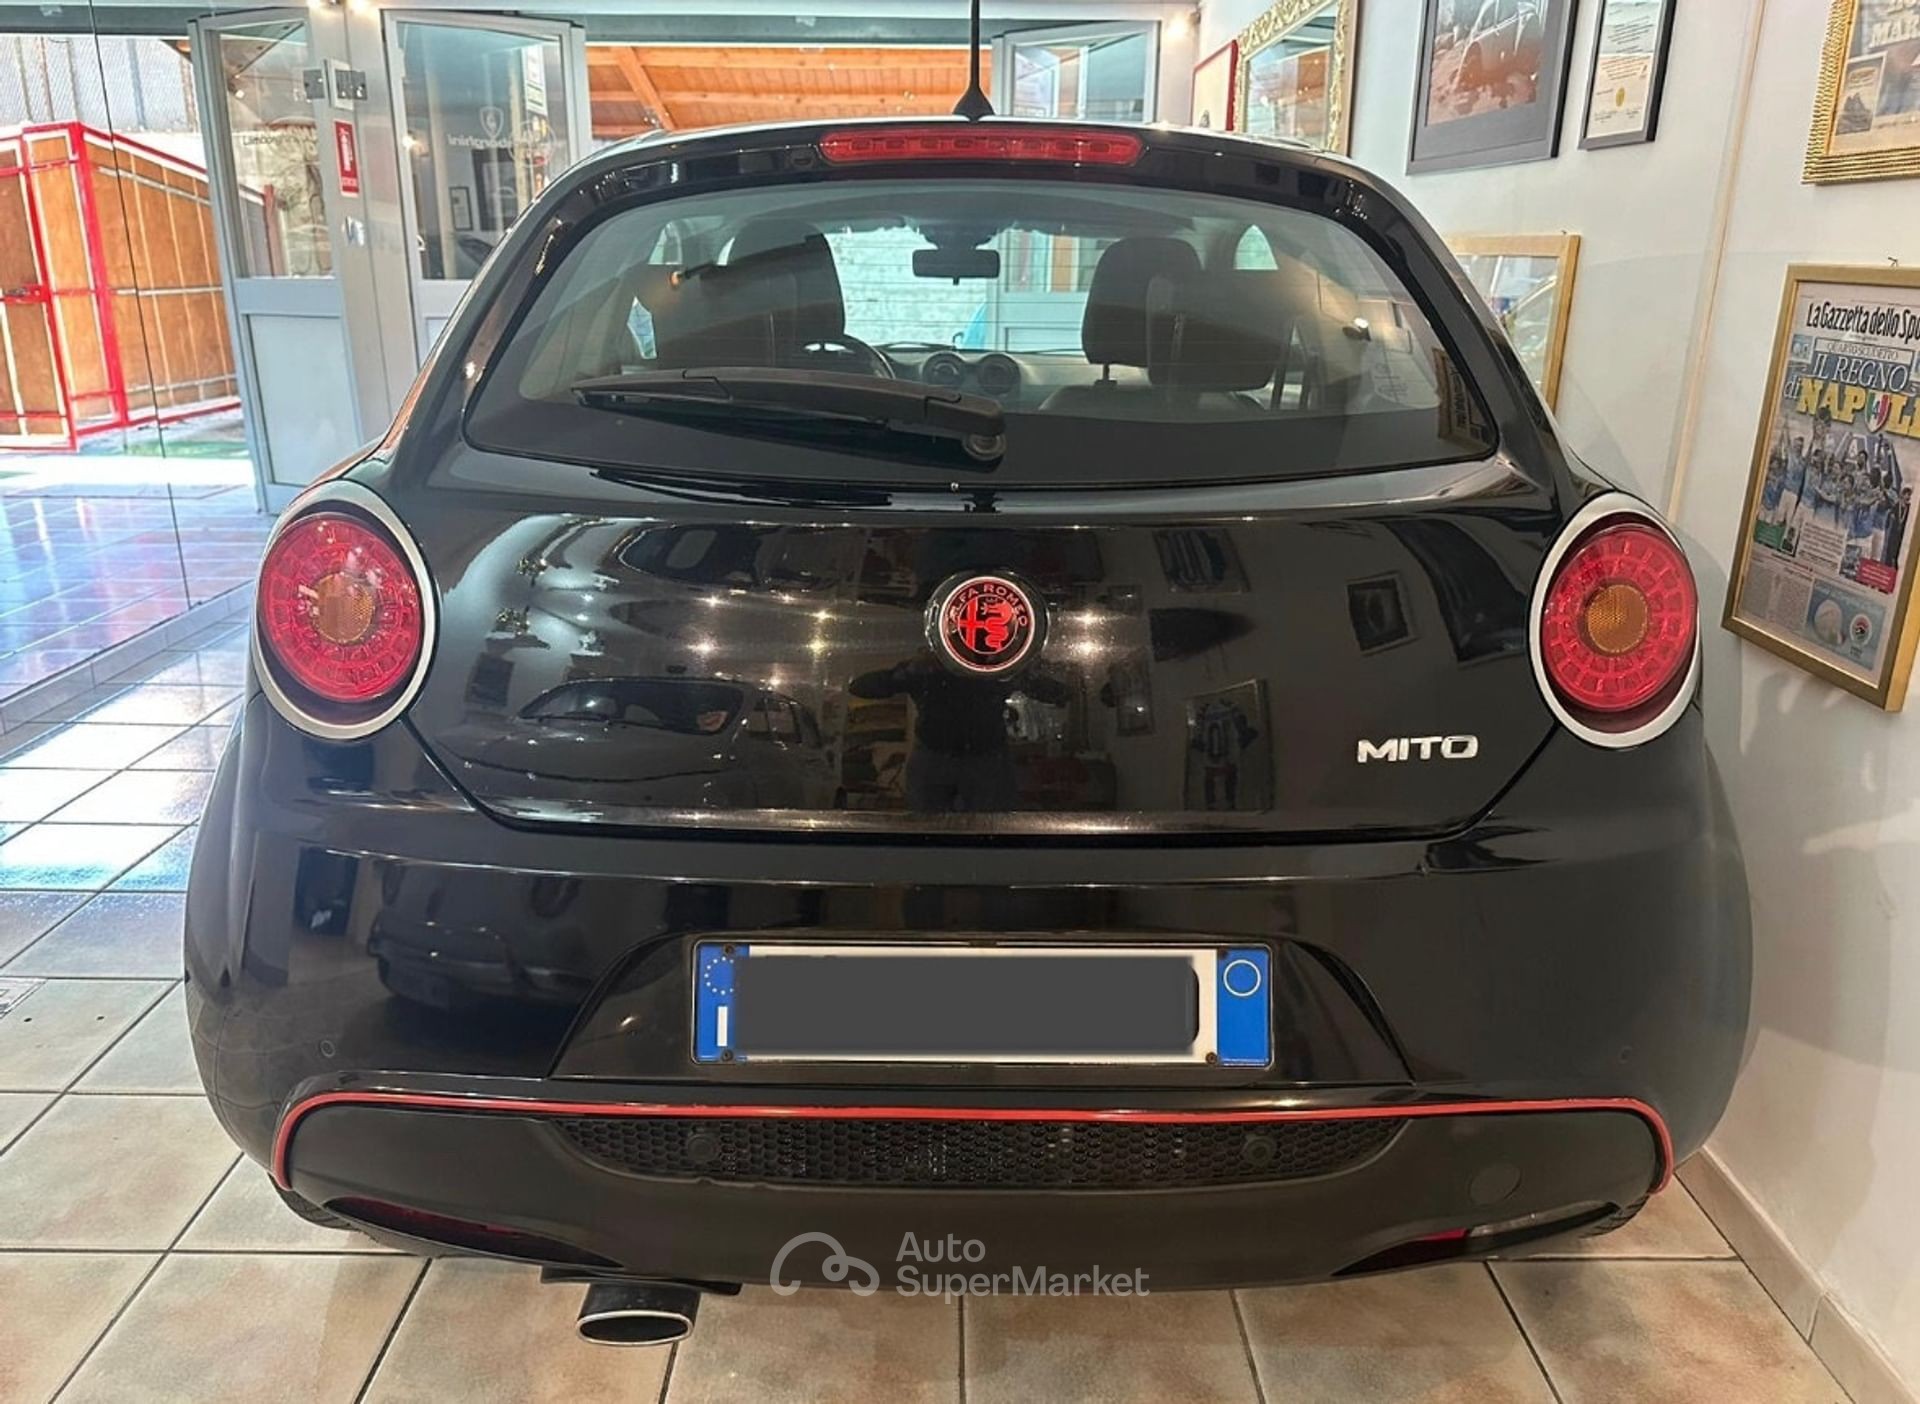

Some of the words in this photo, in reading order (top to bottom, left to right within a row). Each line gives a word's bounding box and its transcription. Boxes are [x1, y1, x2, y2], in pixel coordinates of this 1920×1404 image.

[1868, 307, 1900, 338] dello
[1813, 353, 1829, 379] IL
[1832, 356, 1908, 392] REGNO
[949, 587, 979, 622] ALFA
[983, 584, 1028, 627] ROMEO
[1357, 735, 1479, 763] MITO
